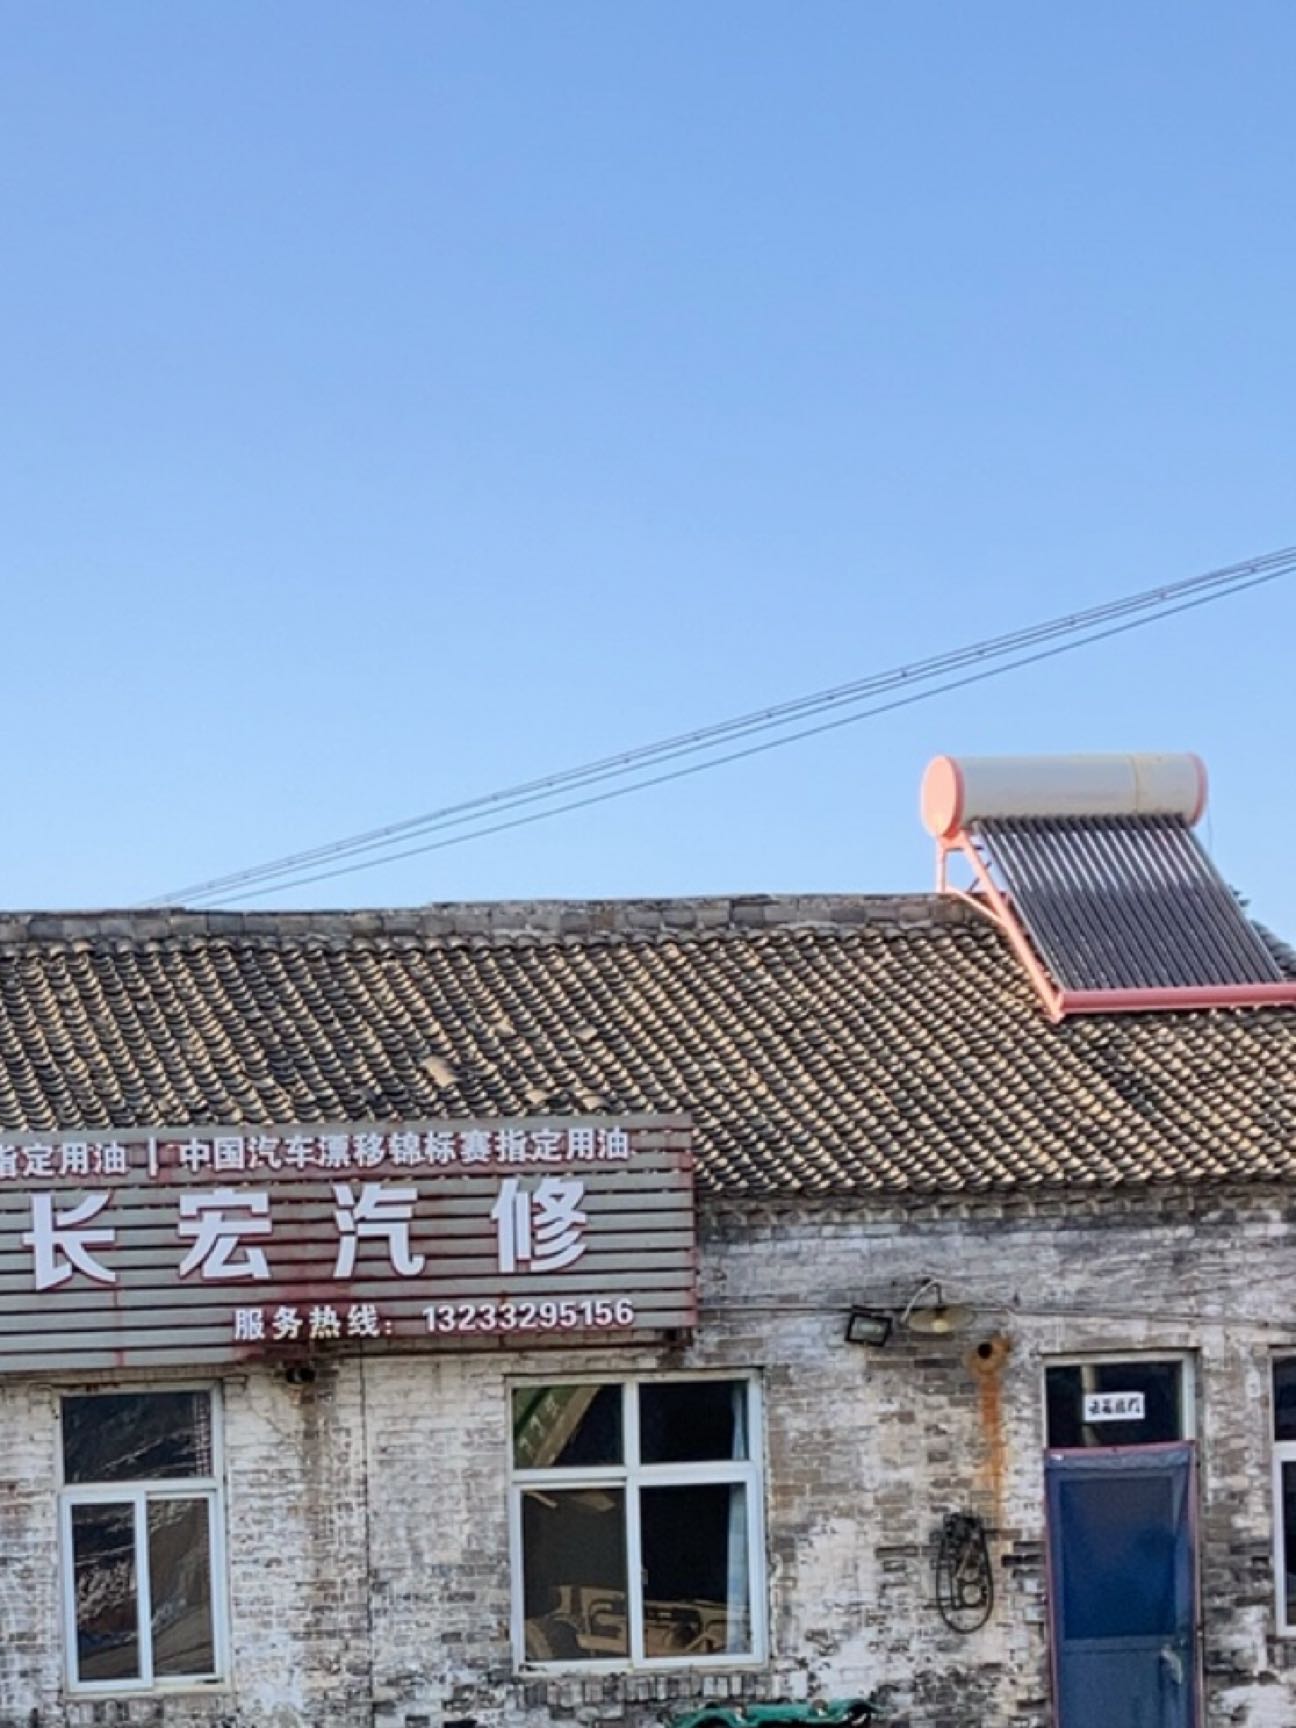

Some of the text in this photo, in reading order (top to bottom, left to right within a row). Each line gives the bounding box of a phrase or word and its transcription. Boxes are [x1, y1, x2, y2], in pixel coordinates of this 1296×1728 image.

[22, 1178, 588, 1290] 长宏汽修
[422, 1298, 635, 1333] 13233295156
